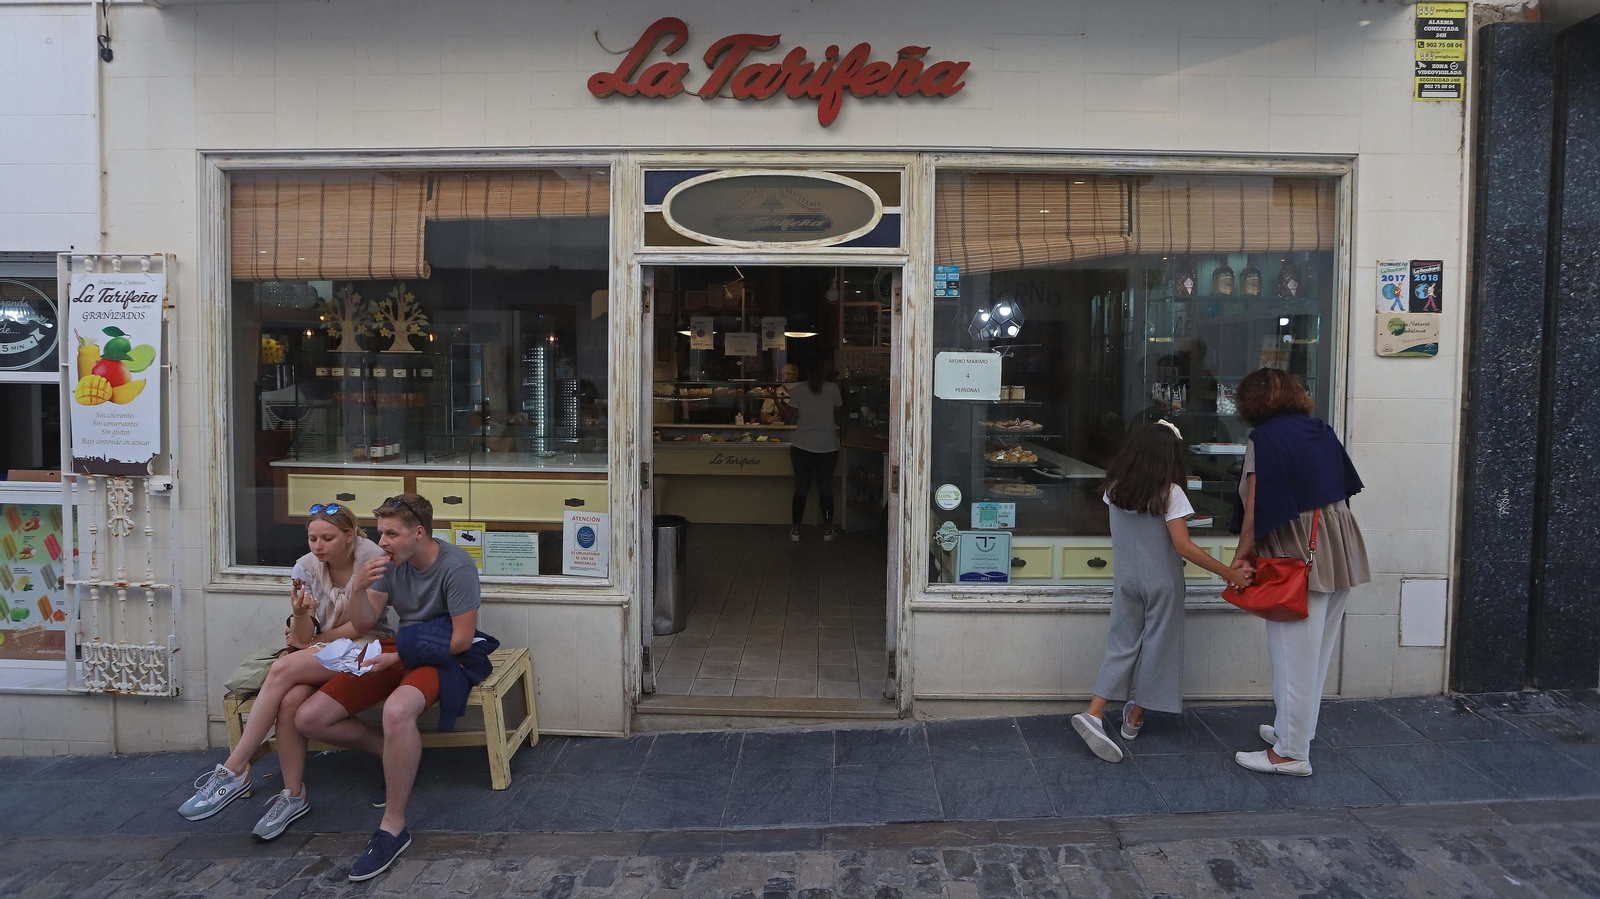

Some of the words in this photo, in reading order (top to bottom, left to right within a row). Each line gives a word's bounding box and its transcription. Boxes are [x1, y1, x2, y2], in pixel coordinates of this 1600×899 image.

[586, 16, 690, 99] La
[699, 32, 972, 128] Tarifeña
[719, 215, 746, 228] La
[72, 283, 95, 303] La
[97, 287, 158, 310] Tarifeña
[82, 311, 146, 322] GRANIZADOS
[95, 411, 105, 419] Sin
[107, 410, 135, 419] colorantes
[111, 428, 130, 438] gluten
[81, 438, 95, 447] Bajo
[95, 437, 122, 445] contenido
[708, 453, 723, 465] La
[725, 455, 762, 469] Tarifeña
